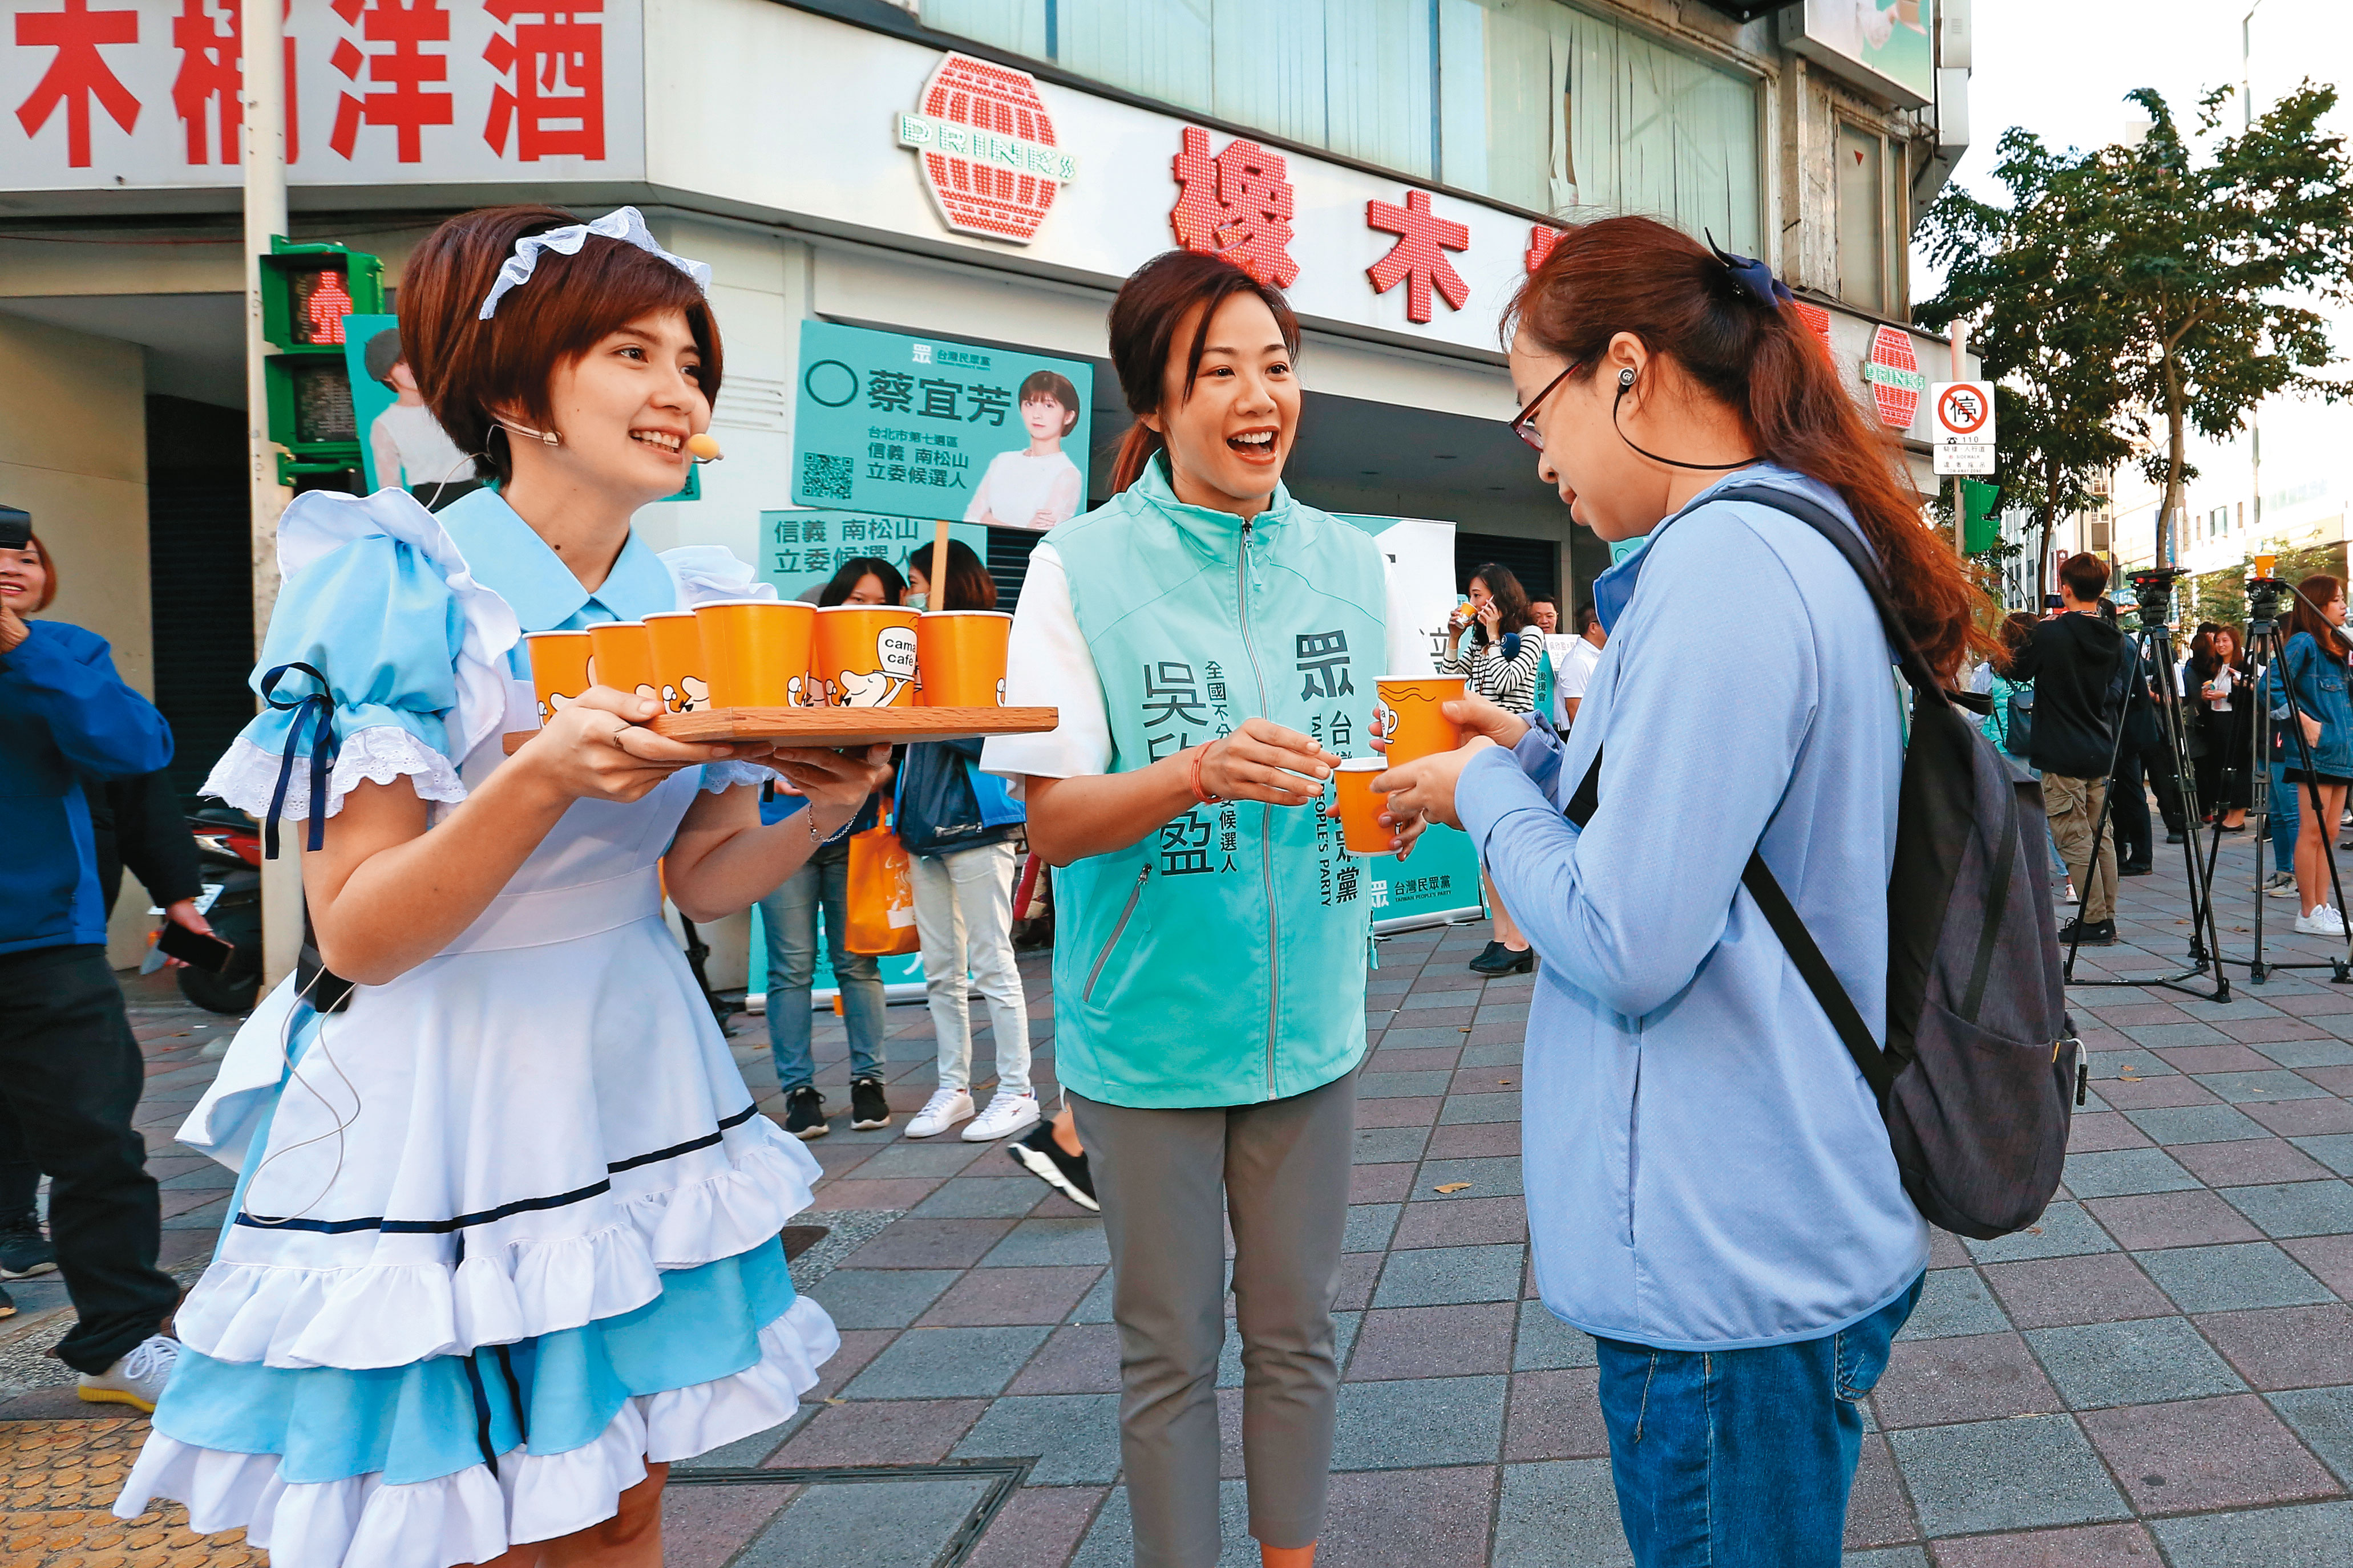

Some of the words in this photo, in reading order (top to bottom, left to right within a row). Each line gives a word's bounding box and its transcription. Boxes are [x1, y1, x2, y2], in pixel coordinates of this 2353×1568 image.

[903, 115, 1075, 179] DRINKS
[1866, 363, 1925, 390] DRINKS
[866, 370, 1012, 426] 蔡宜芳
[1950, 396, 1976, 422] 停
[868, 442, 905, 461] 信義
[915, 448, 969, 469] 南松山
[866, 462, 968, 490] 立委候選人
[774, 520, 827, 542] 信義
[842, 518, 918, 541] 南松山
[885, 639, 916, 653] cama
[888, 654, 913, 666] café
[1319, 858, 1332, 907] PARTY
[1394, 875, 1452, 896] 台灣民眾黨
